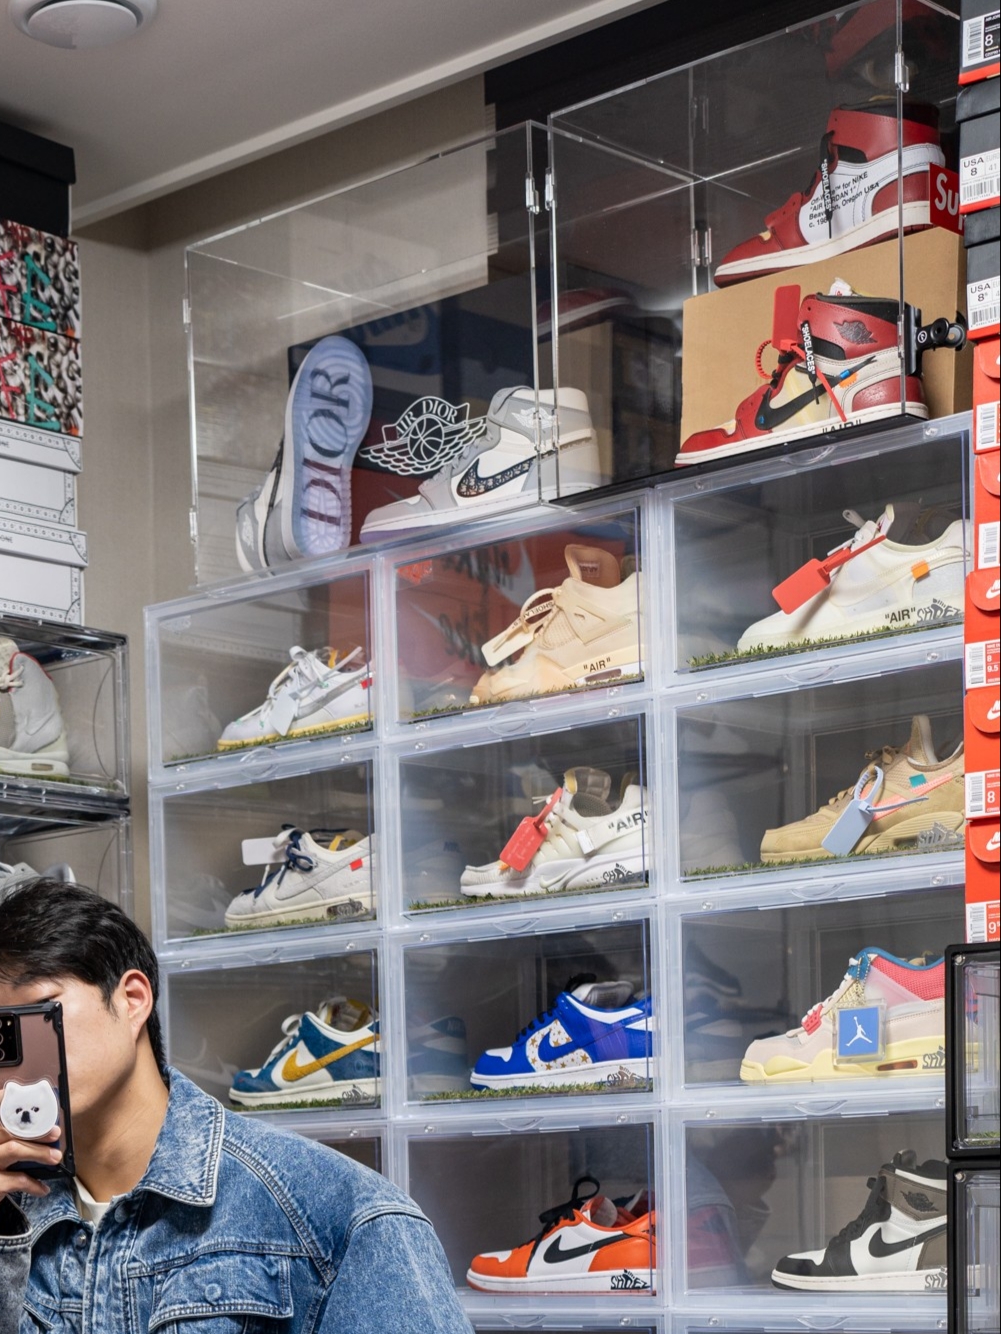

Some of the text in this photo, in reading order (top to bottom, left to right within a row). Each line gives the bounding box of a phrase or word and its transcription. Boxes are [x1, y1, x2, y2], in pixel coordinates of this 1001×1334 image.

[984, 34, 993, 46] 8
[963, 156, 985, 168] USA
[852, 170, 869, 185] NIKE
[970, 167, 978, 176] 8
[842, 191, 863, 207] Oregon
[970, 282, 991, 294] USA
[801, 323, 816, 375] "SHOELACES"
[396, 399, 458, 435] AIR DIOR
[302, 367, 351, 526] DIOR
[885, 606, 916, 624] "AIR"
[583, 656, 612, 674] "AIR"
[986, 790, 996, 804] 8
